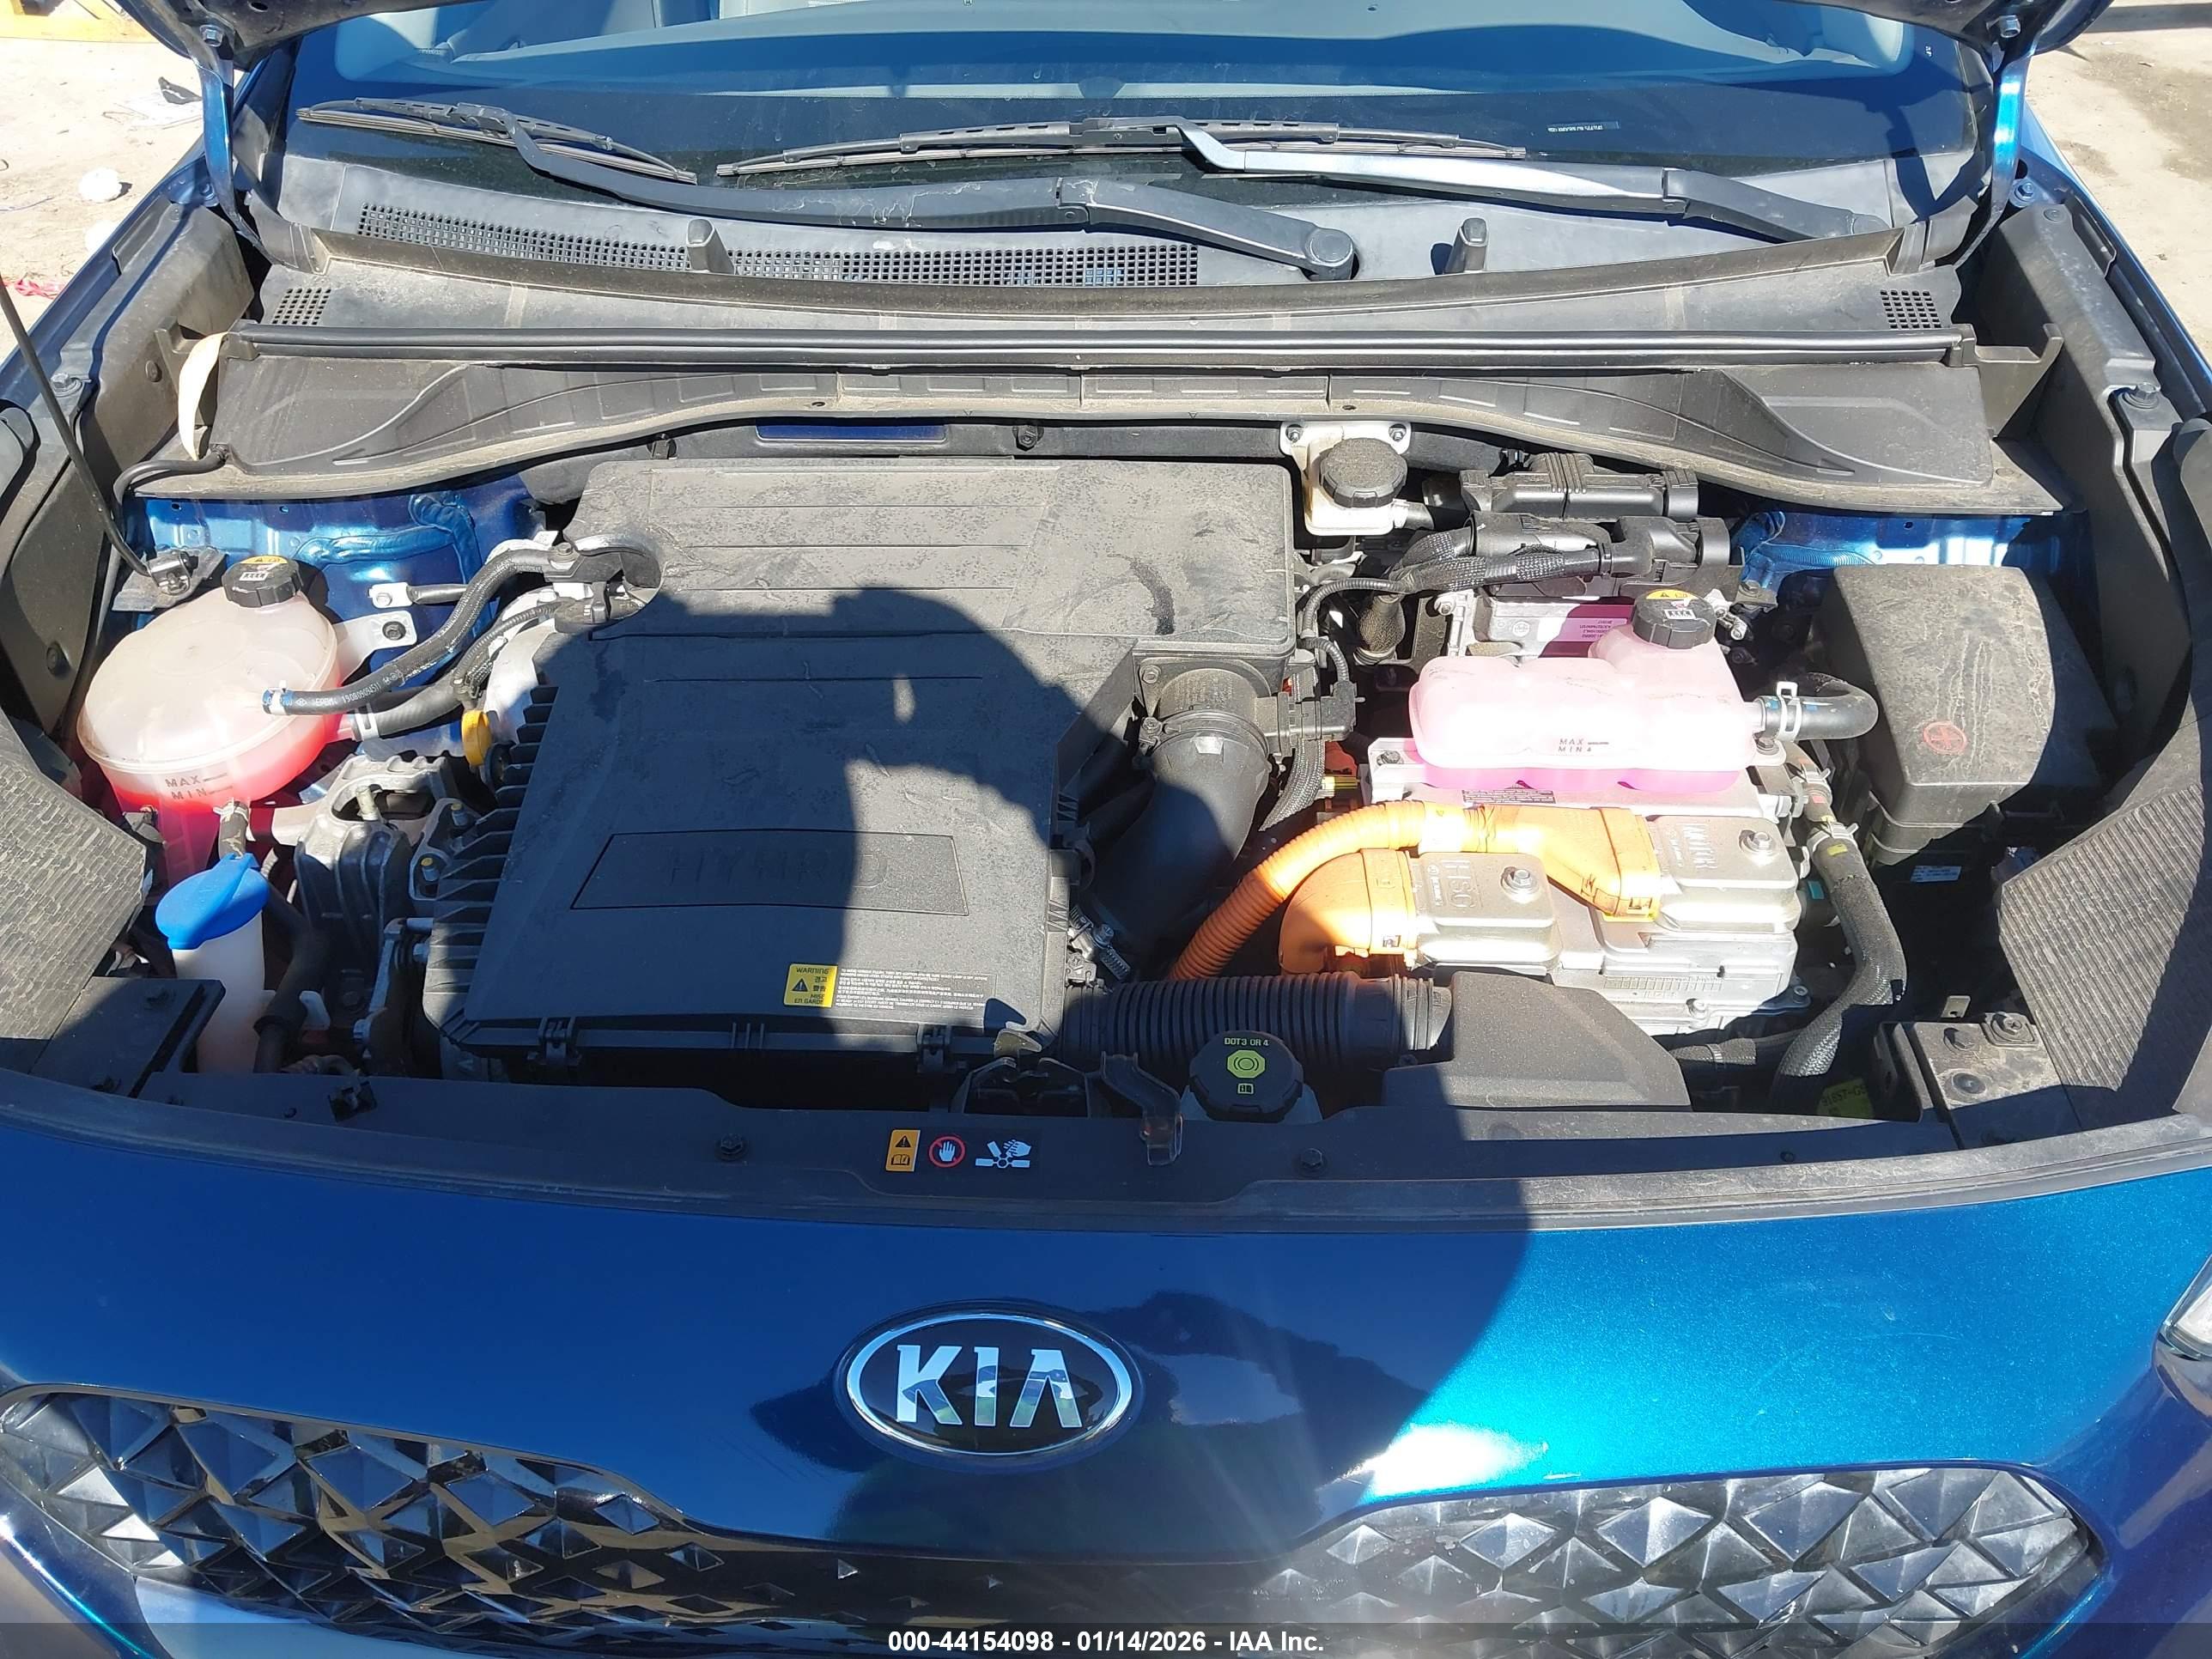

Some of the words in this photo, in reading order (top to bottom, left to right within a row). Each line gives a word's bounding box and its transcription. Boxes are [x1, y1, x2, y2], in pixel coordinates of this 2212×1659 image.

[165, 775, 201, 787] MAX
[171, 787, 208, 800] MIN
[1224, 1037, 1248, 1046] DOT3
[896, 1344, 1083, 1428] KIA
